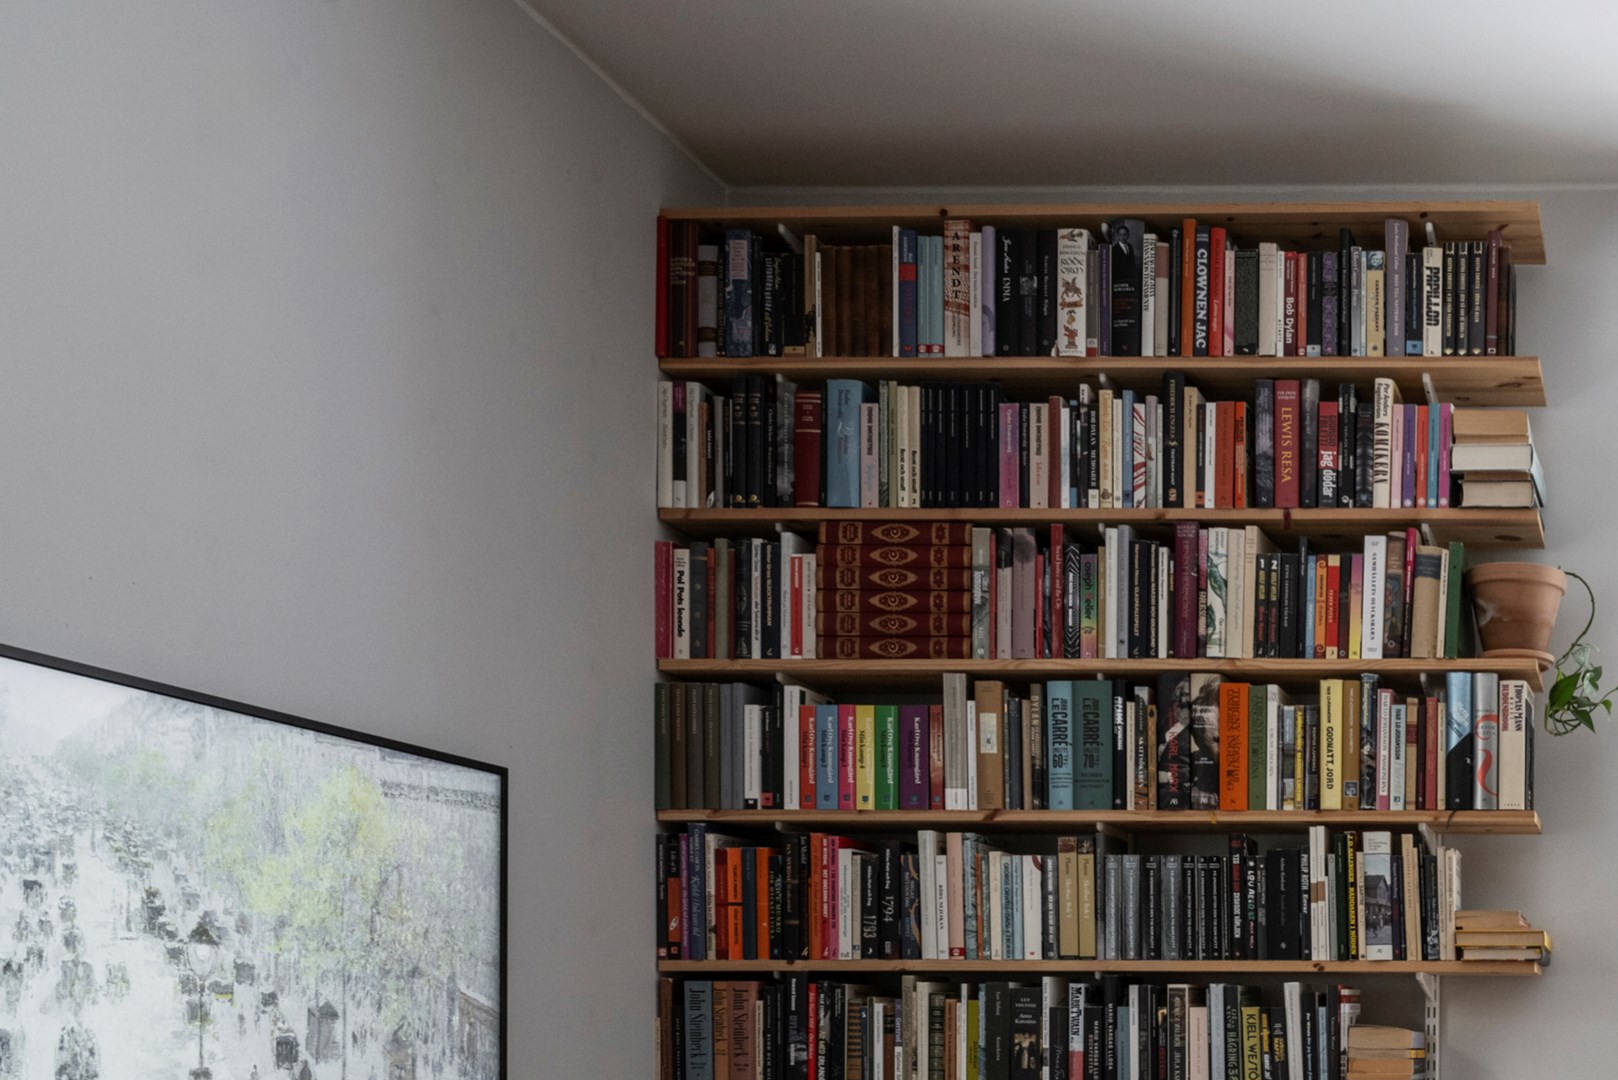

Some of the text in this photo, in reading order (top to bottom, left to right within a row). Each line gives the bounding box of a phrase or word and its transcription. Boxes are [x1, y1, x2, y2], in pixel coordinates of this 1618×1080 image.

[952, 232, 960, 299] ARENDT
[1002, 277, 1011, 302] EMMA
[1196, 248, 1208, 349] CLOWNEN JAC
[1425, 267, 1440, 326] PAPILLON
[1285, 297, 1294, 344] Bob Dylan
[1281, 407, 1293, 483] LEWIS RESA
[1374, 422, 1389, 484] KOMIKERN
[1321, 450, 1336, 497] jag dödar
[974, 570, 984, 605] Tomorrow
[1031, 695, 1039, 725] DYLAN
[1052, 712, 1072, 746] CARRÉ
[1083, 712, 1104, 746] CARRÉ
[1232, 688, 1240, 732] TORGNY
[1515, 684, 1524, 731] THOMAS MANN
[913, 717, 921, 784] Karl Ove Knausgård
[1326, 767, 1334, 789] JORD
[862, 915, 877, 938] 1793
[882, 895, 894, 922] 1794
[689, 988, 706, 1058] John Steinbeck
[714, 988, 727, 1043] John Steinbeck
[733, 988, 749, 1058] John Steinbeck
[1071, 987, 1081, 1036] MARK TWAIN
[1246, 1014, 1256, 1040] KJELL
